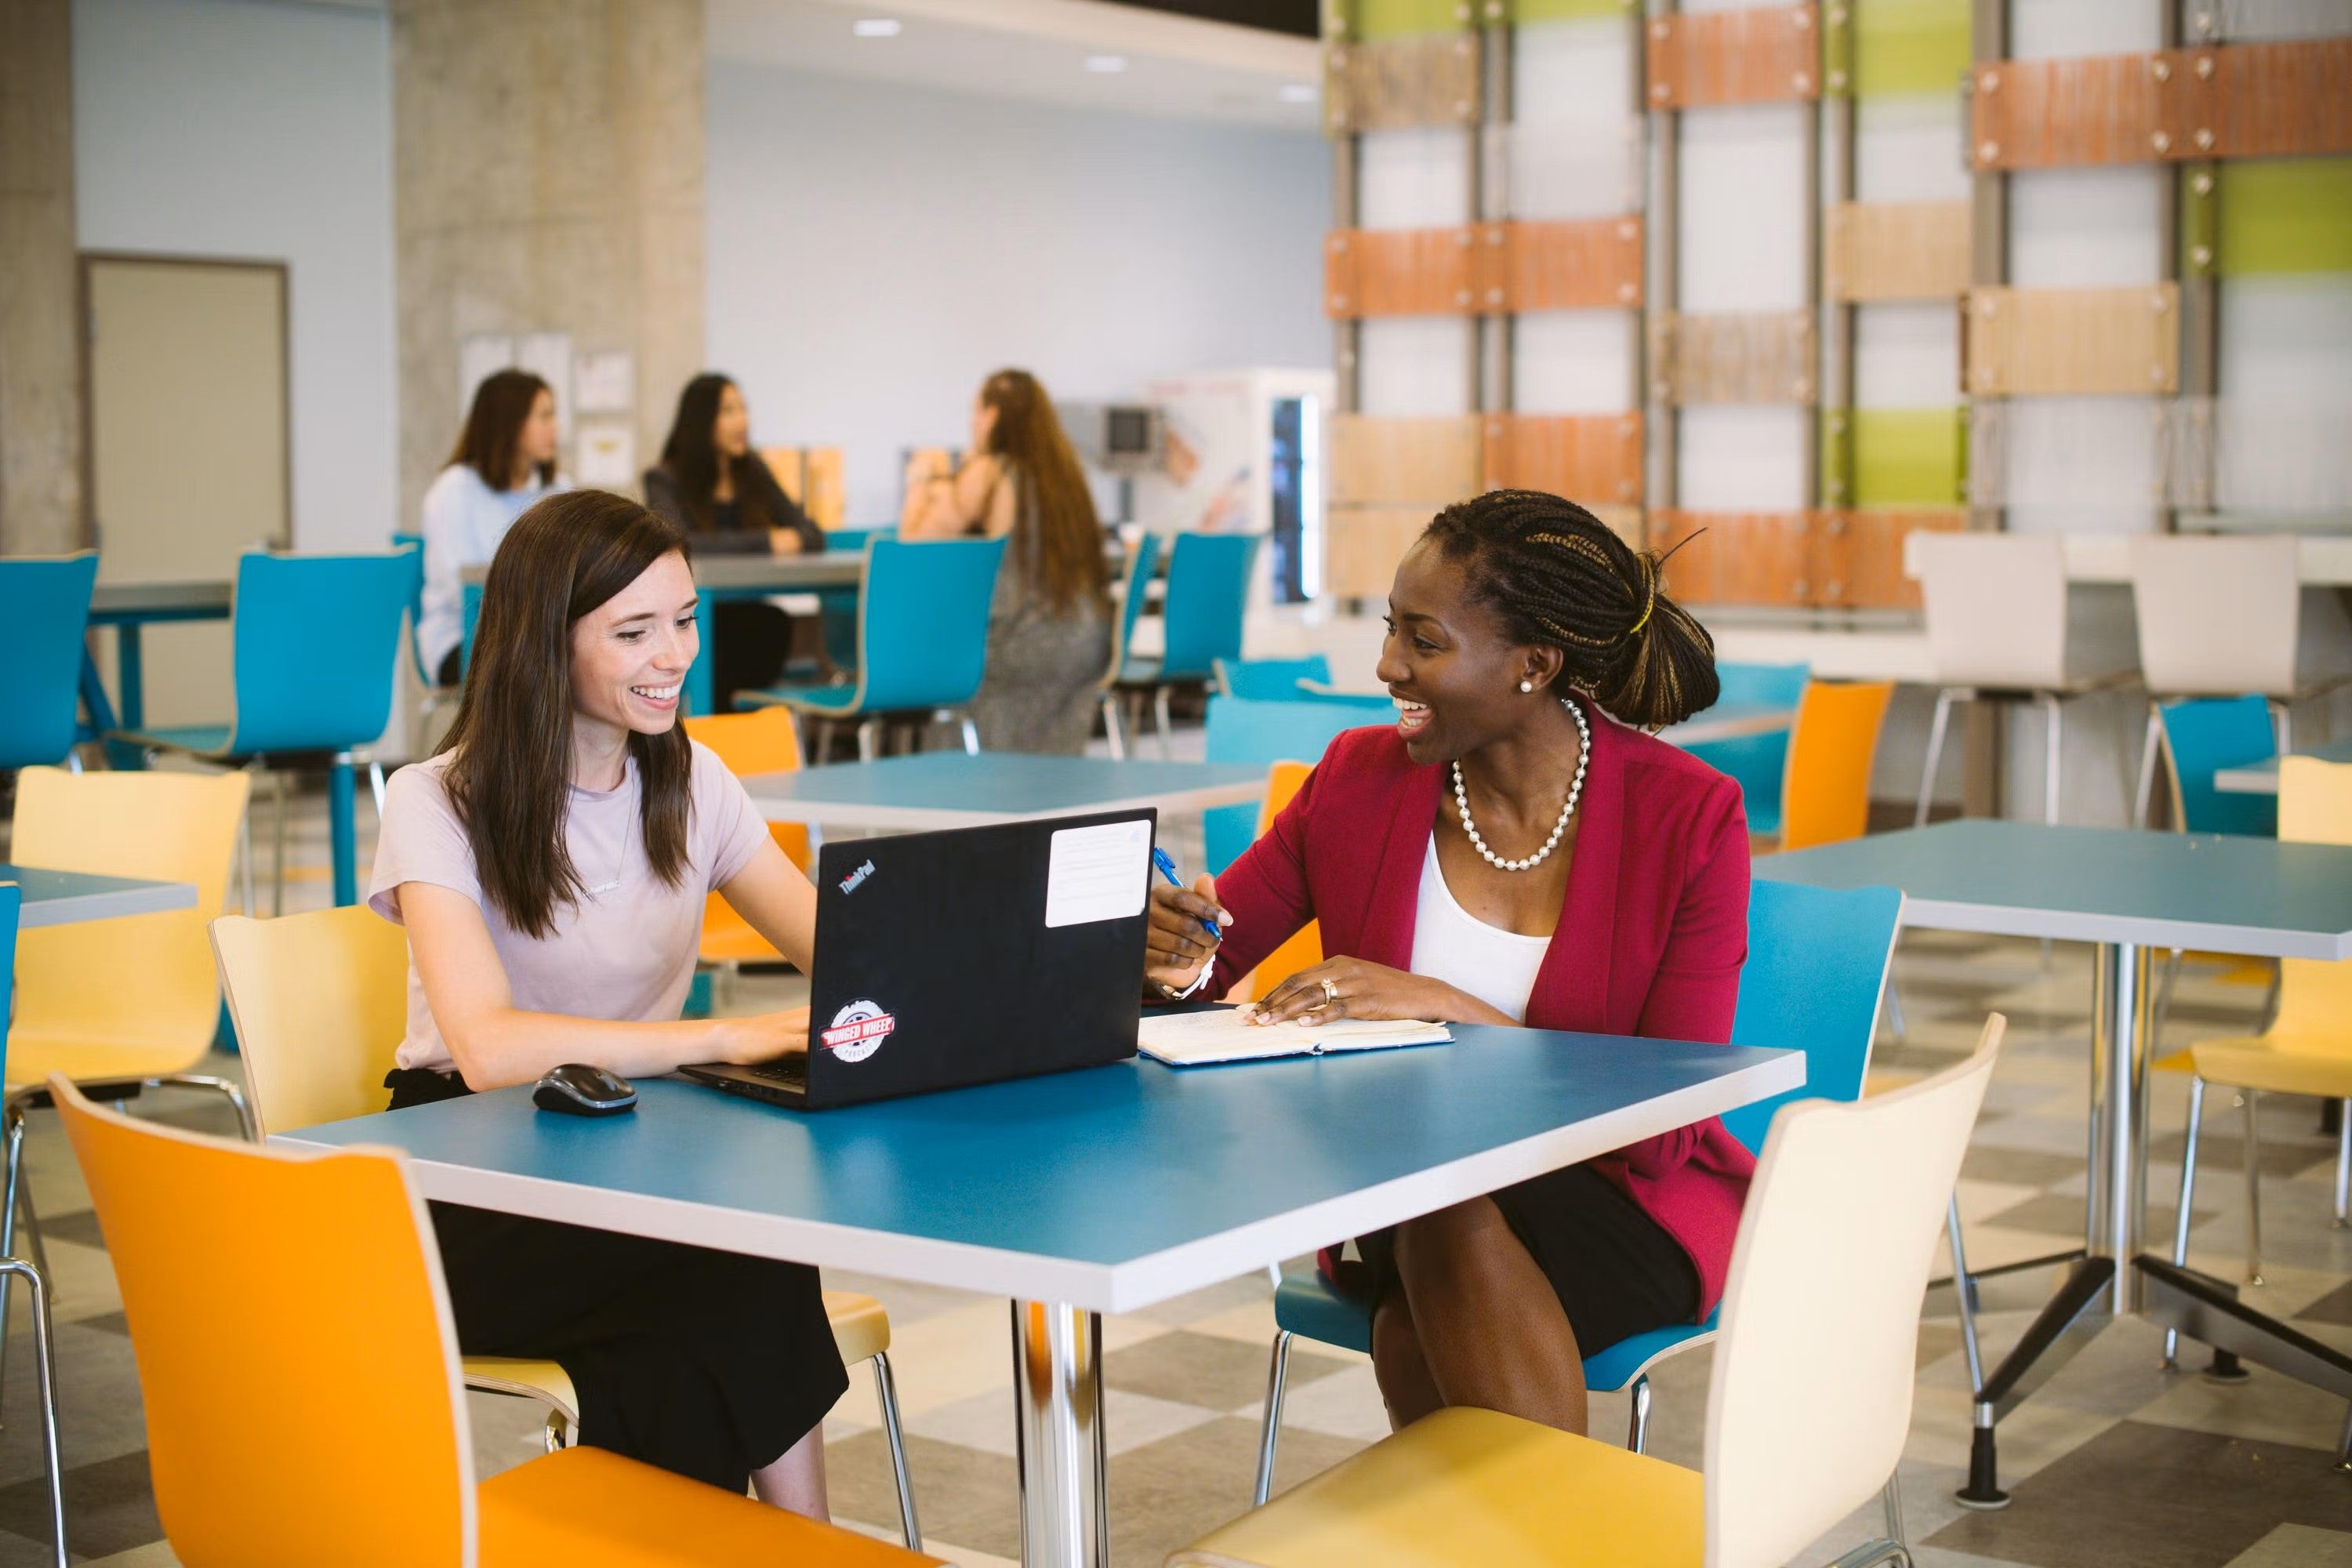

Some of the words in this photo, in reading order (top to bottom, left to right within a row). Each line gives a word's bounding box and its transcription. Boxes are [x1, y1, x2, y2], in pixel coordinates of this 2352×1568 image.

[839, 859, 876, 895] ThinkPad
[822, 1025, 861, 1046] WINGED
[862, 1017, 892, 1036] WHEEL
